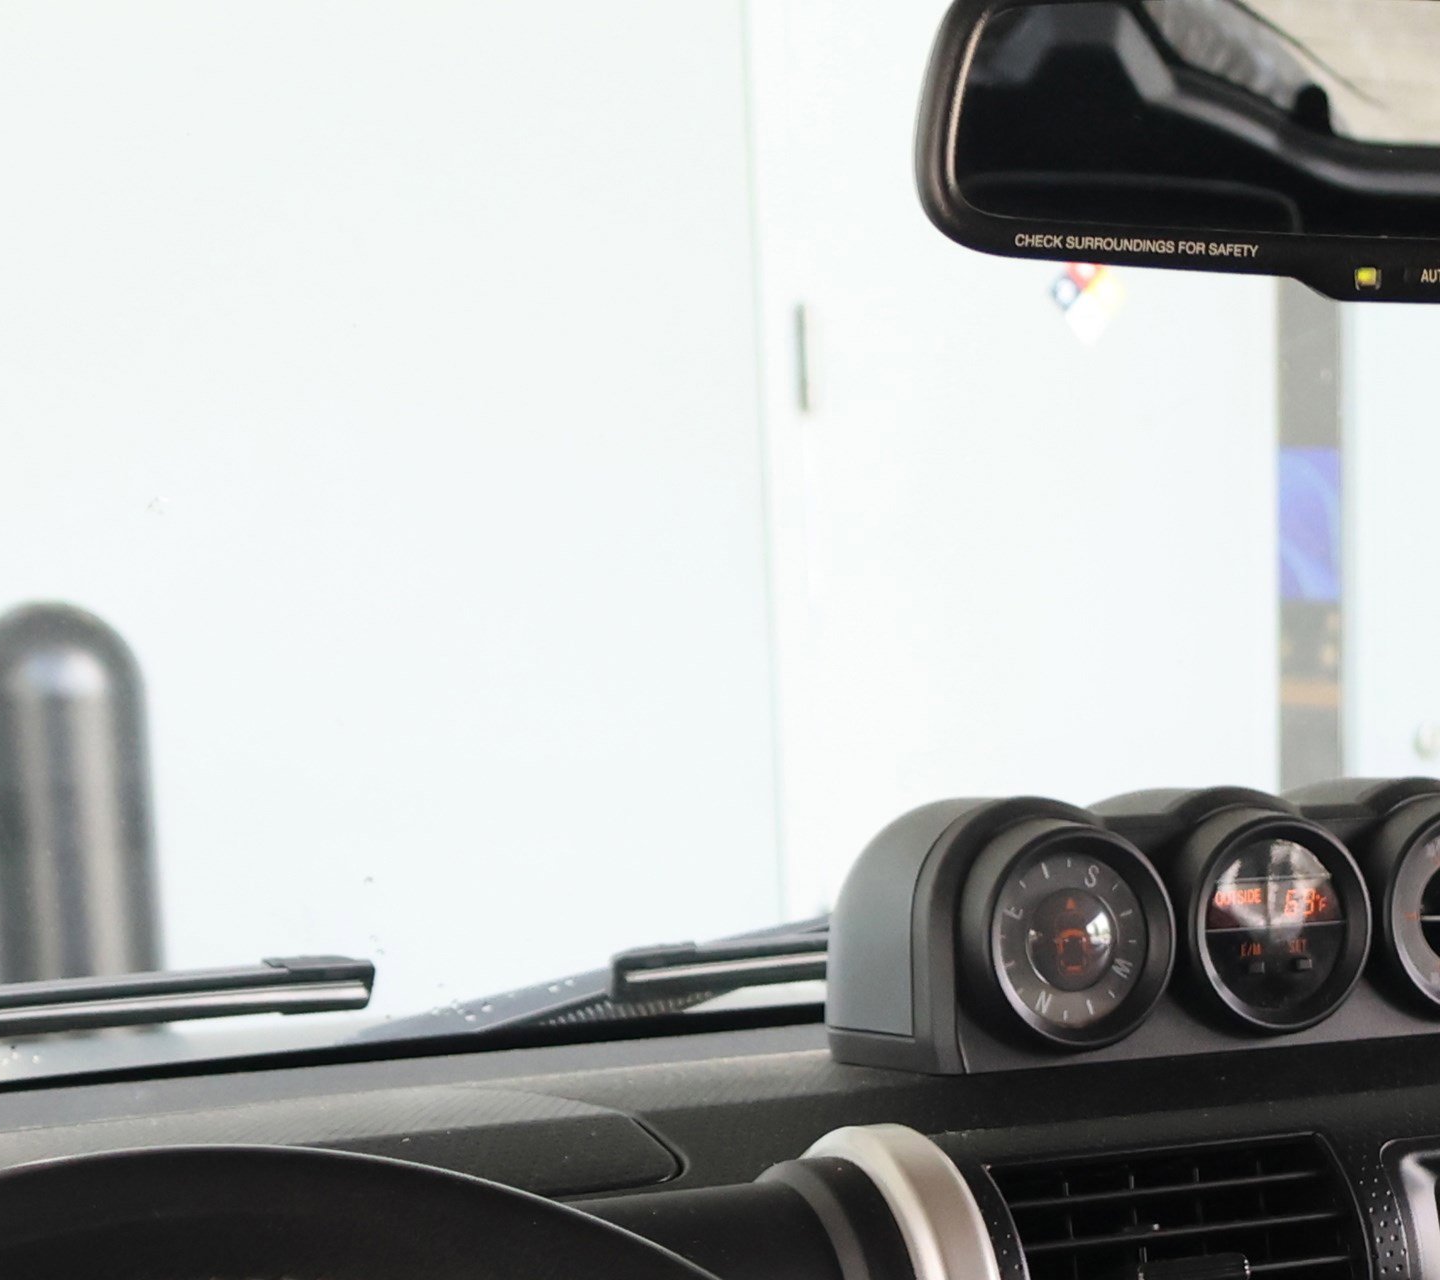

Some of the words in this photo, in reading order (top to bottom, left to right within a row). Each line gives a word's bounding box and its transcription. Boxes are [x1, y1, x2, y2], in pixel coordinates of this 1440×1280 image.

[1014, 233, 1062, 249] CHECK
[1065, 235, 1175, 254] SURROUNDINGS
[1177, 241, 1205, 256] FOR
[1207, 242, 1258, 258] SAFETY
[1084, 864, 1100, 888] S
